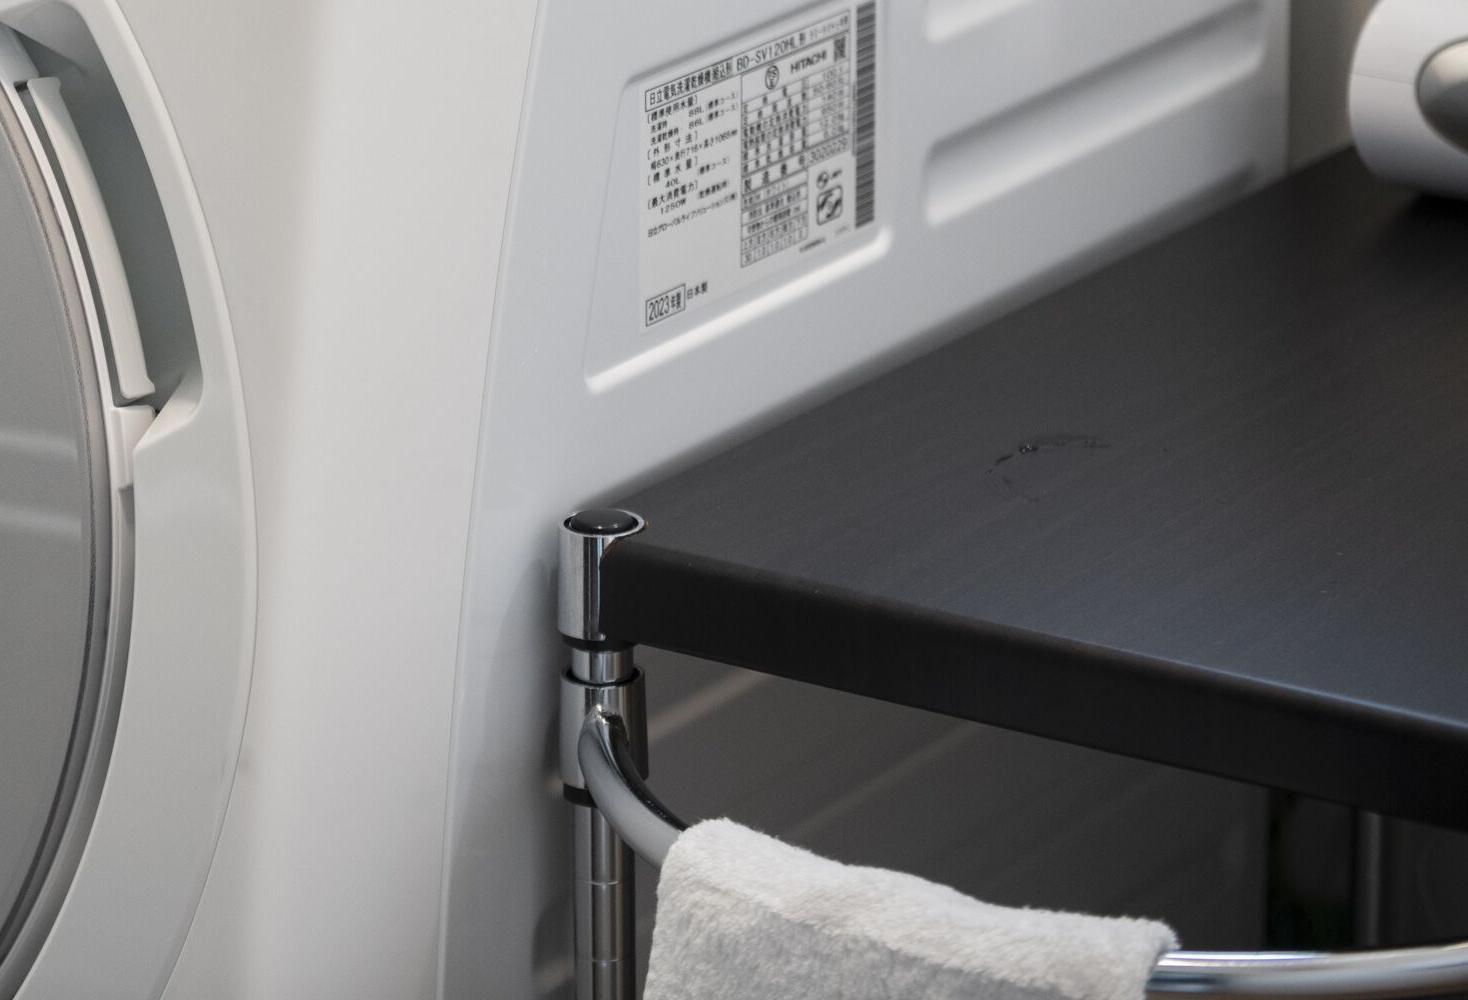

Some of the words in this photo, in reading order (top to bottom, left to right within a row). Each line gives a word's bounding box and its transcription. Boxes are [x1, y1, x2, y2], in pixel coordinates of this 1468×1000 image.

[790, 49, 827, 73] HITACHI
[686, 281, 709, 301] 日本製
